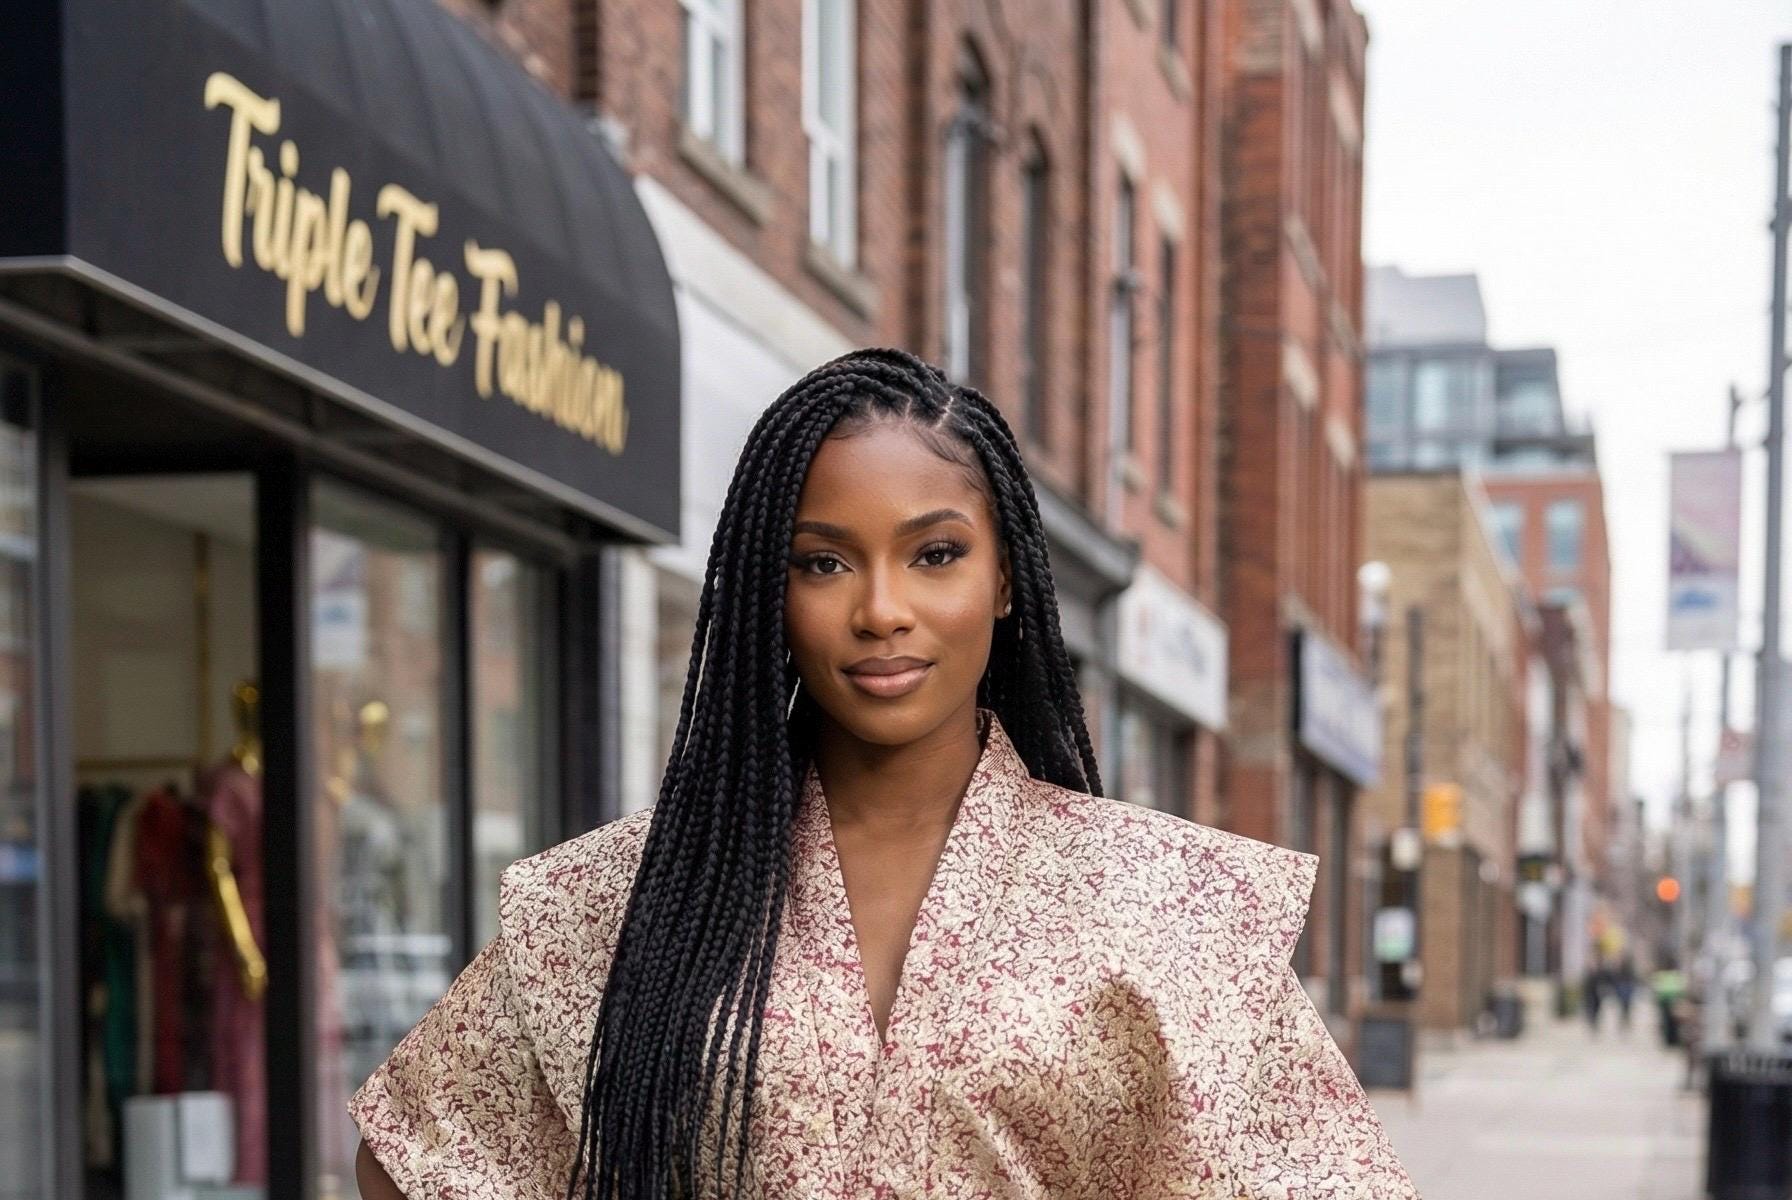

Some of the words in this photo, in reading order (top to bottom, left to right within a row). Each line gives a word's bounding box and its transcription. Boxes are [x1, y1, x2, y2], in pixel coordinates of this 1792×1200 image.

[204, 72, 379, 337] Triple
[376, 184, 464, 366] Tee
[464, 239, 629, 454] Fashion
